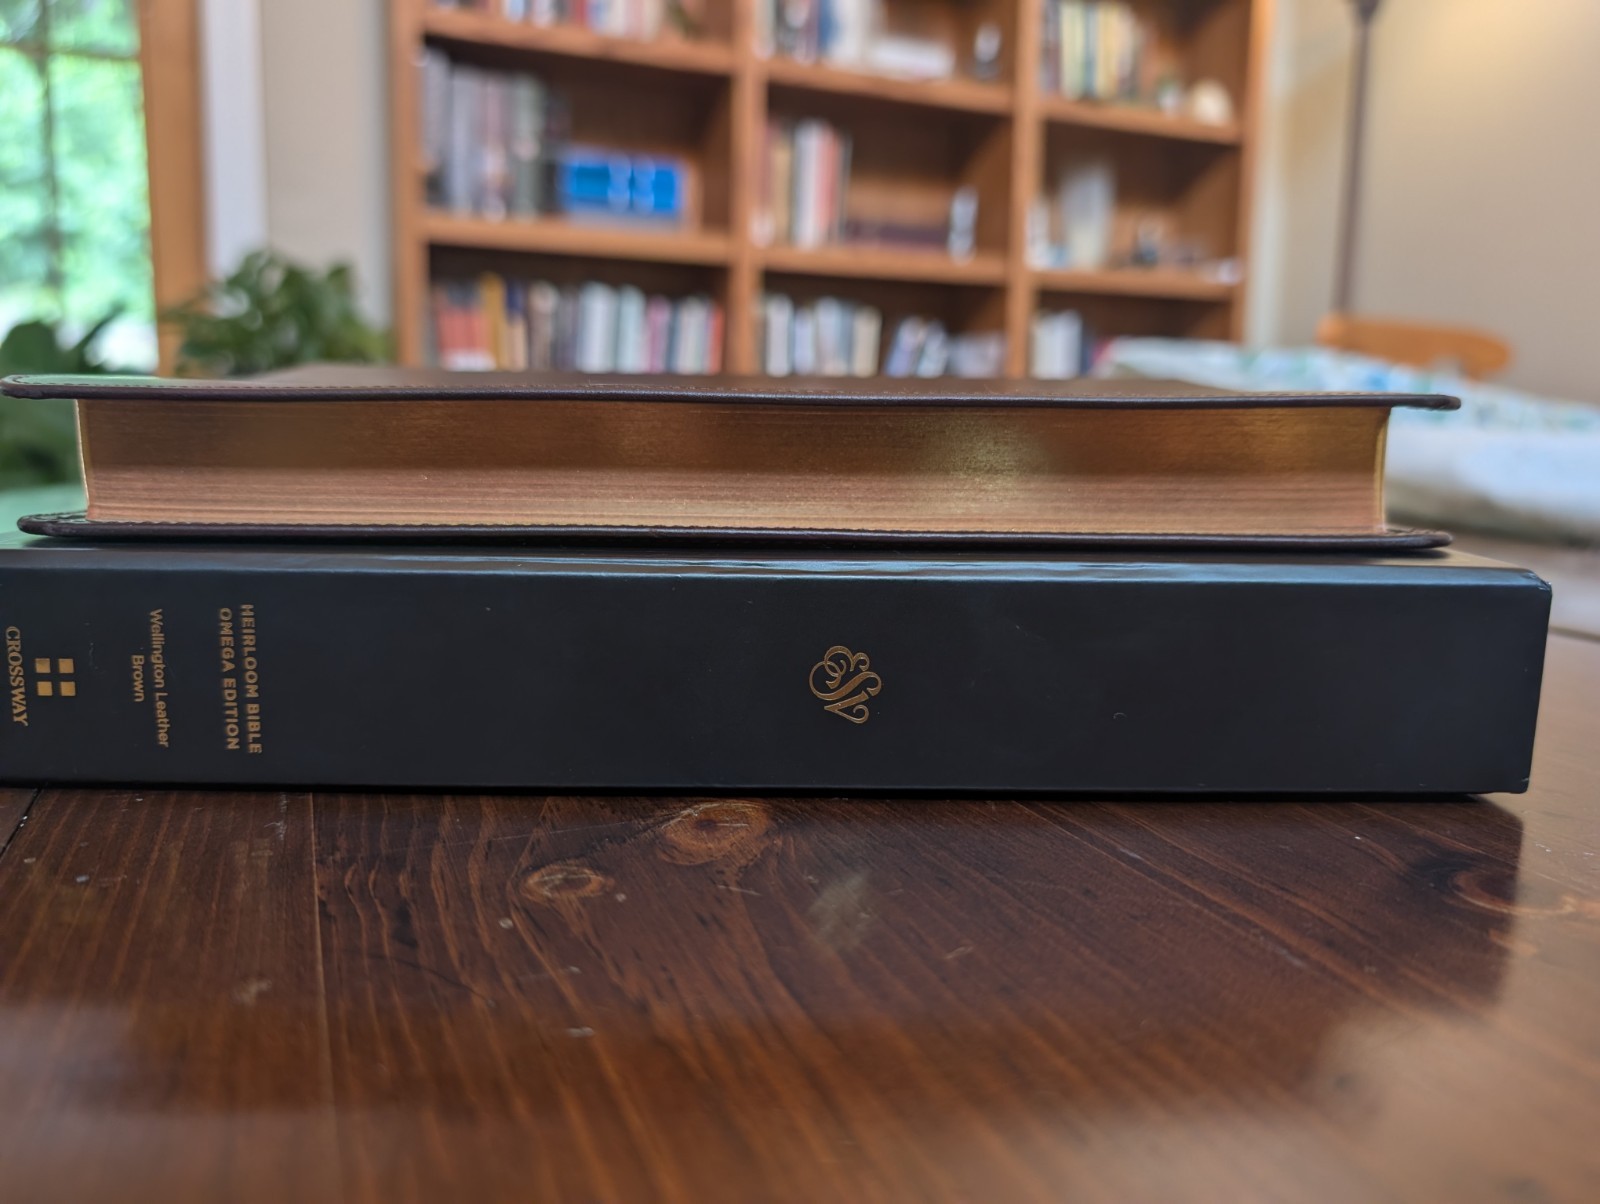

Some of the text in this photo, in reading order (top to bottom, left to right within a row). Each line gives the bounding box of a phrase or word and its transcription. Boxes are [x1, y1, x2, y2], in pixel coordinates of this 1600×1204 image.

[5, 626, 28, 727] CROSSWAY
[131, 654, 145, 702] Brown
[150, 608, 170, 748] Wellington Leather
[219, 607, 240, 750] OMEGA EDITION
[241, 604, 262, 753] HEIRLOOM BIBLE
